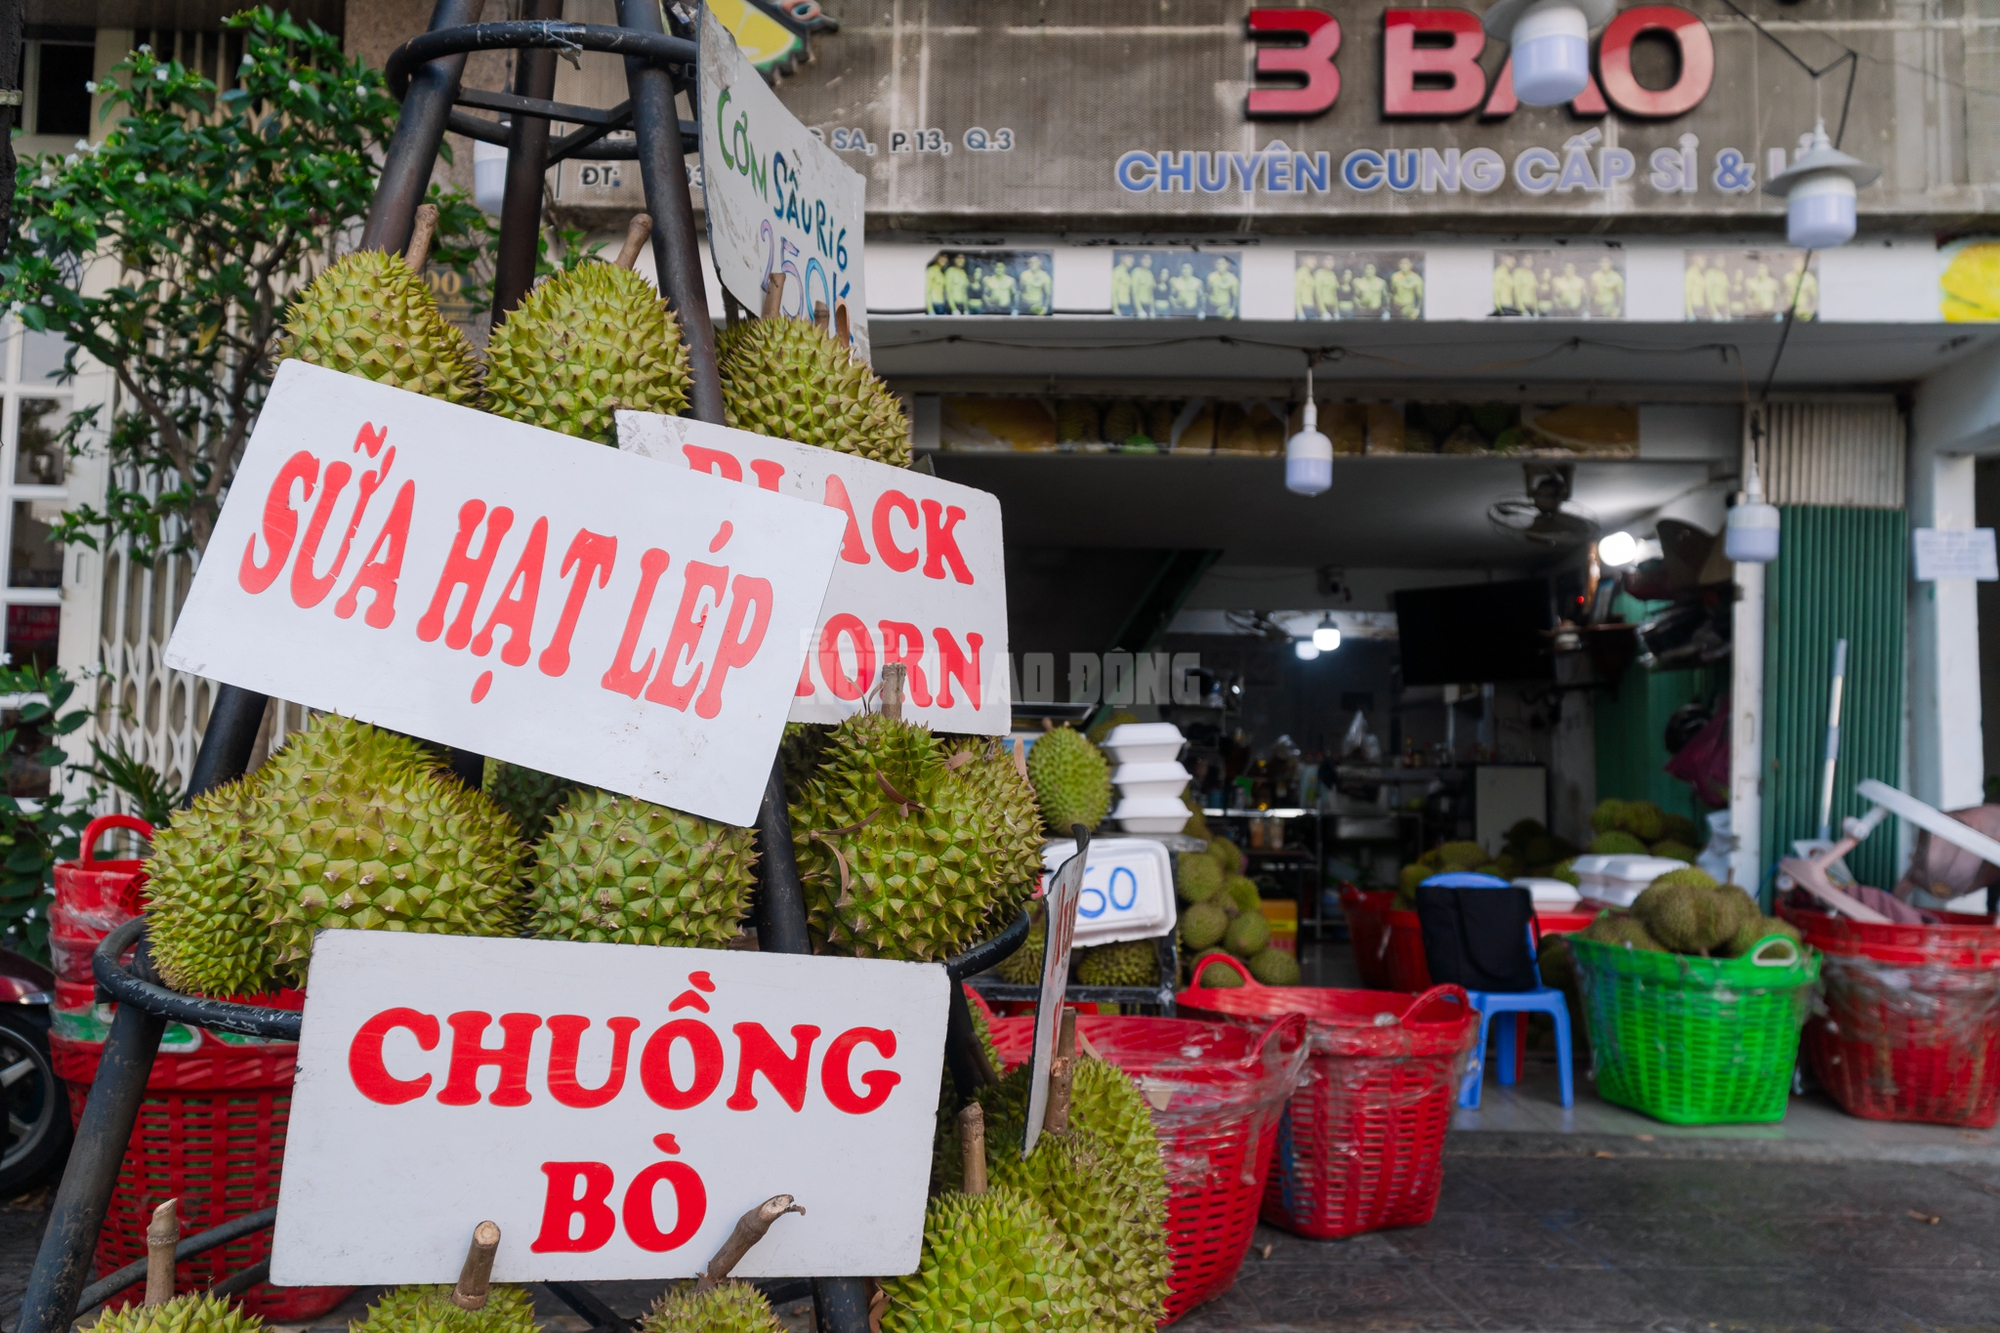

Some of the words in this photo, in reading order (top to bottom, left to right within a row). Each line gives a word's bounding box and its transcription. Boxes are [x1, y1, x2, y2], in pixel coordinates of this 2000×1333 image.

[1247, 7, 1343, 118] 3
[831, 126, 876, 156] SA,
[888, 126, 952, 156] P.13,
[963, 126, 1016, 151] Q.3
[1114, 139, 1330, 193] CHUYÊN
[1341, 147, 1505, 194] CUNG
[1514, 126, 1636, 194] CẤP
[1712, 147, 1756, 195] &
[237, 420, 416, 630] SỮA
[415, 498, 618, 704] HẠT
[600, 519, 774, 720] LÉP
[795, 612, 984, 712] ORN
[347, 970, 902, 1115] CHUỒNG
[530, 1132, 708, 1254] BÒ
